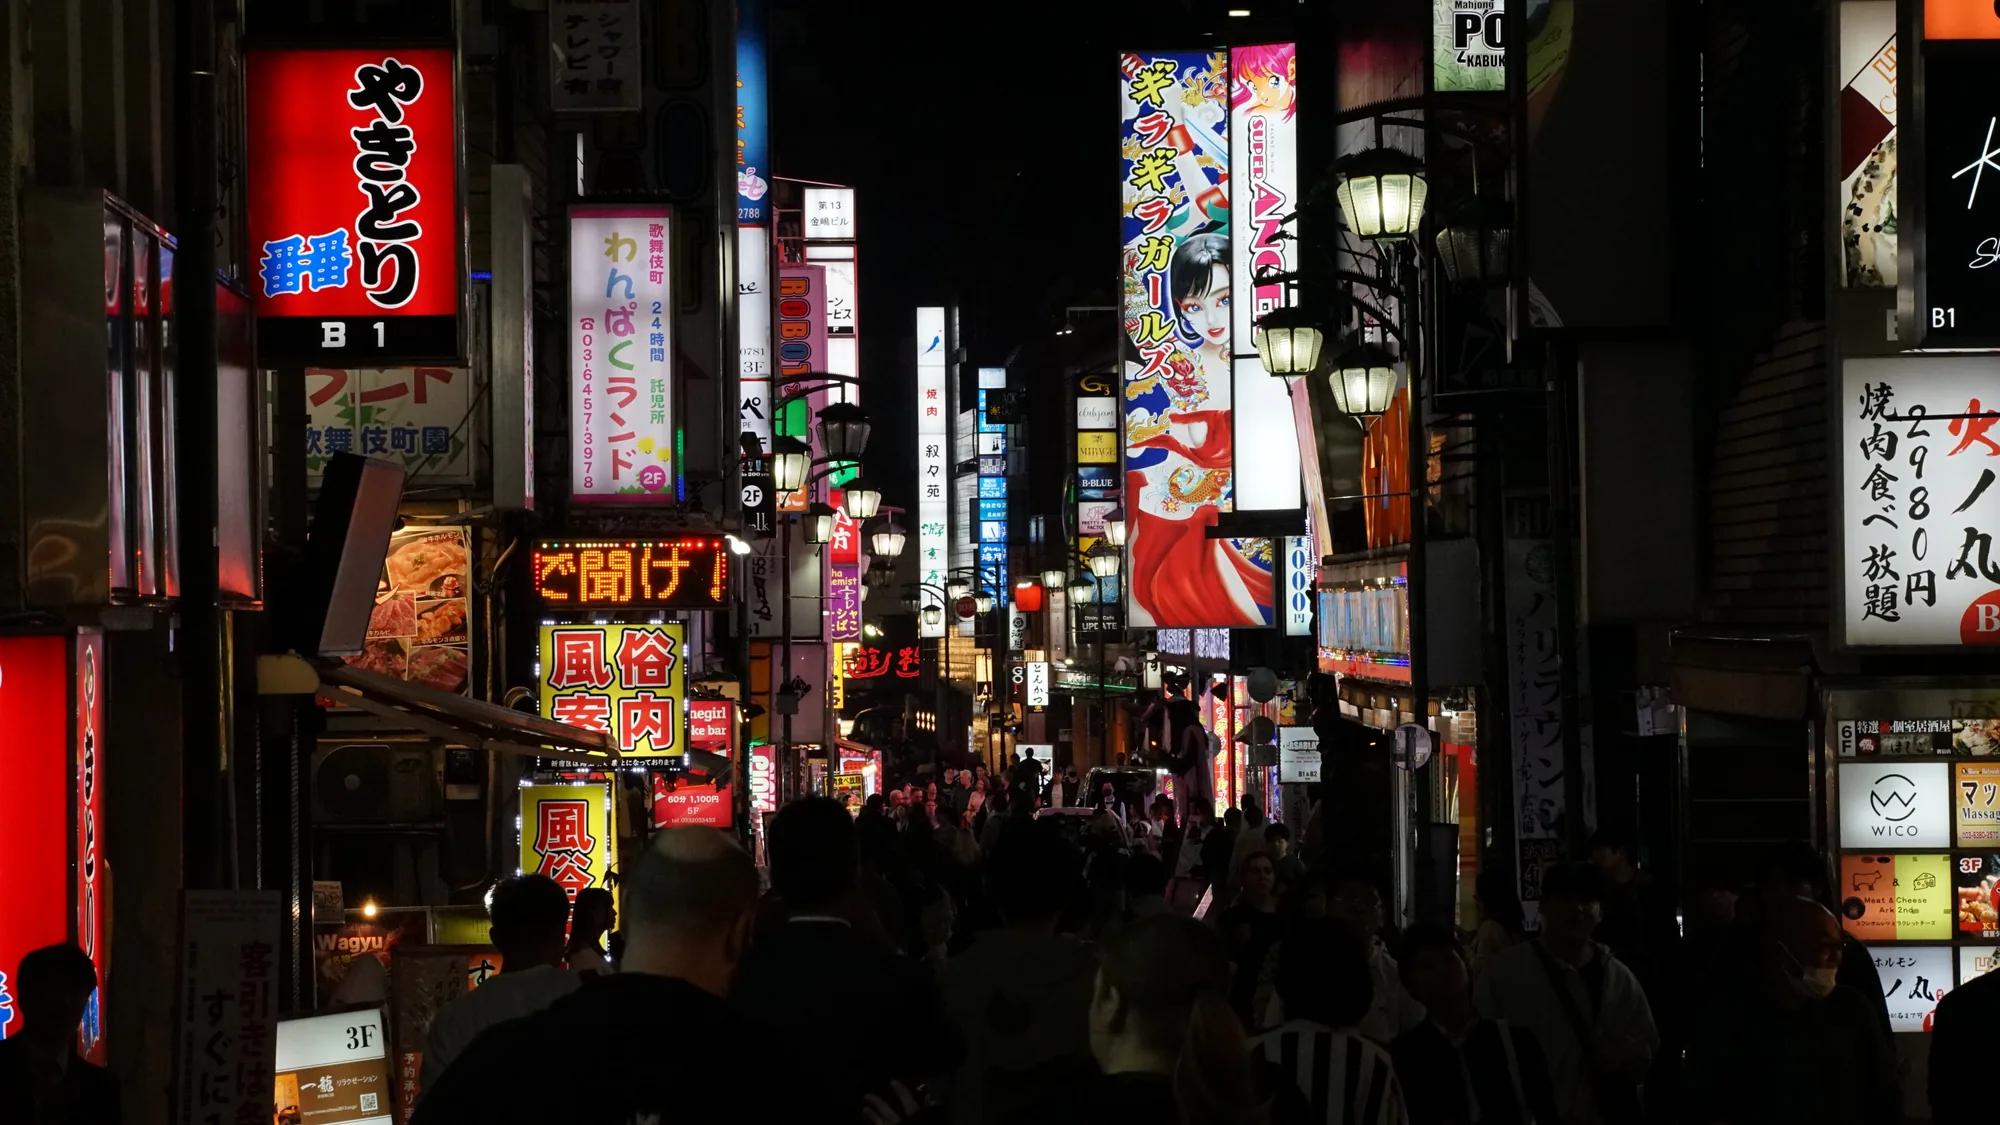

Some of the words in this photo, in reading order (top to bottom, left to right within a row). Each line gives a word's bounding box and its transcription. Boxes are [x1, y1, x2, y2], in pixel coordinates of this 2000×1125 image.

[1251, 118, 1266, 184] SUPER
[347, 57, 425, 309] やきとり
[1128, 58, 1179, 382] ギラギラガールズ
[649, 224, 664, 284] 歌舞伎町
[650, 302, 664, 362] 24時間
[1932, 308, 1955, 328] B1
[604, 232, 637, 481] わんぱくランド
[744, 361, 765, 373] 3F
[650, 379, 665, 424] 託児所
[926, 389, 938, 417] 焼肉
[643, 472, 662, 484] 2F
[925, 444, 940, 498] 叙々苑
[743, 488, 761, 502] 2F
[1860, 382, 1901, 622] 焼肉食べ放題
[1905, 405, 1937, 607] 2980円
[548, 627, 677, 689] 風俗
[1033, 664, 1044, 704] とんかつ
[552, 692, 675, 751] 案内
[707, 725, 727, 736] bar
[690, 796, 719, 804] 1,100円
[1961, 781, 1997, 806] マッ
[1872, 826, 1918, 837] WICO
[1960, 858, 1983, 873] 3F
[316, 933, 383, 955] Wagyu
[1875, 957, 1917, 968] ホルモン
[346, 1024, 377, 1050] 3F
